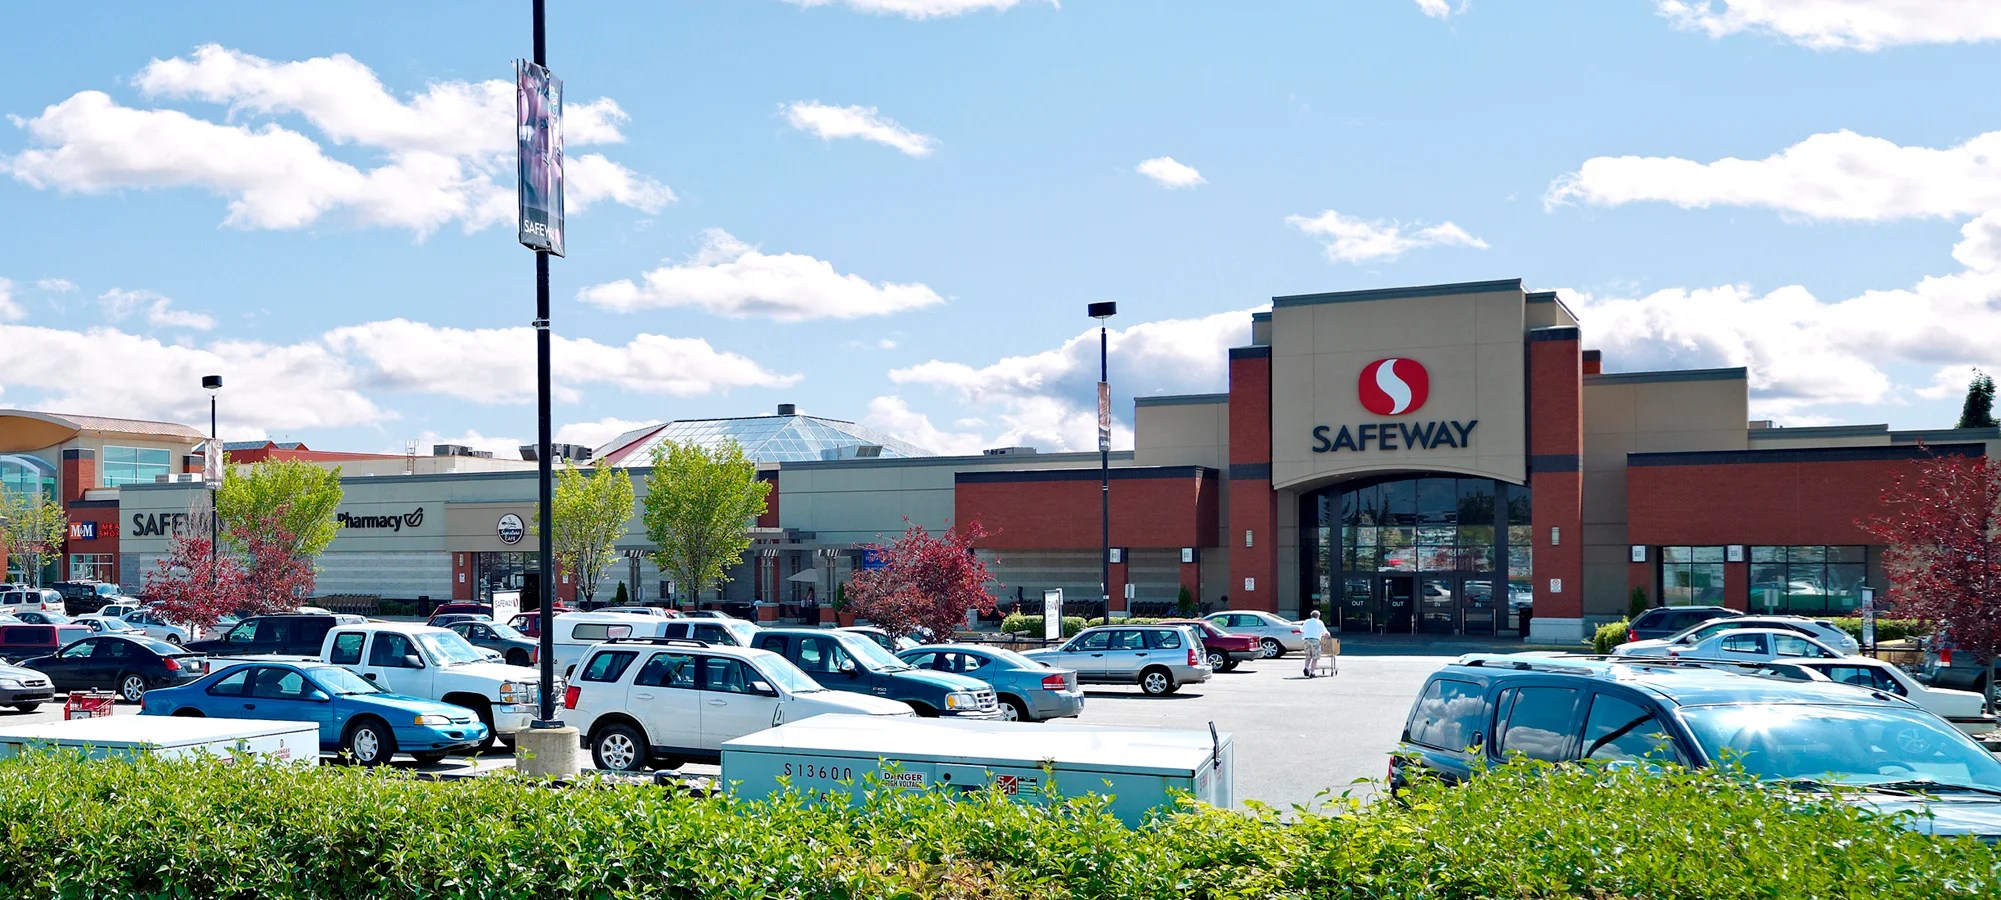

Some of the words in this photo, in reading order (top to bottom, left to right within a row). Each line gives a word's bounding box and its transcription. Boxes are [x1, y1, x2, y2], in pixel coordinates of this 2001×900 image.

[1312, 420, 1478, 453] SAFEWAY
[70, 524, 93, 537] M&M
[132, 512, 227, 536] SAFE
[337, 512, 402, 532] Pharmacy
[884, 772, 923, 781] DANGER
